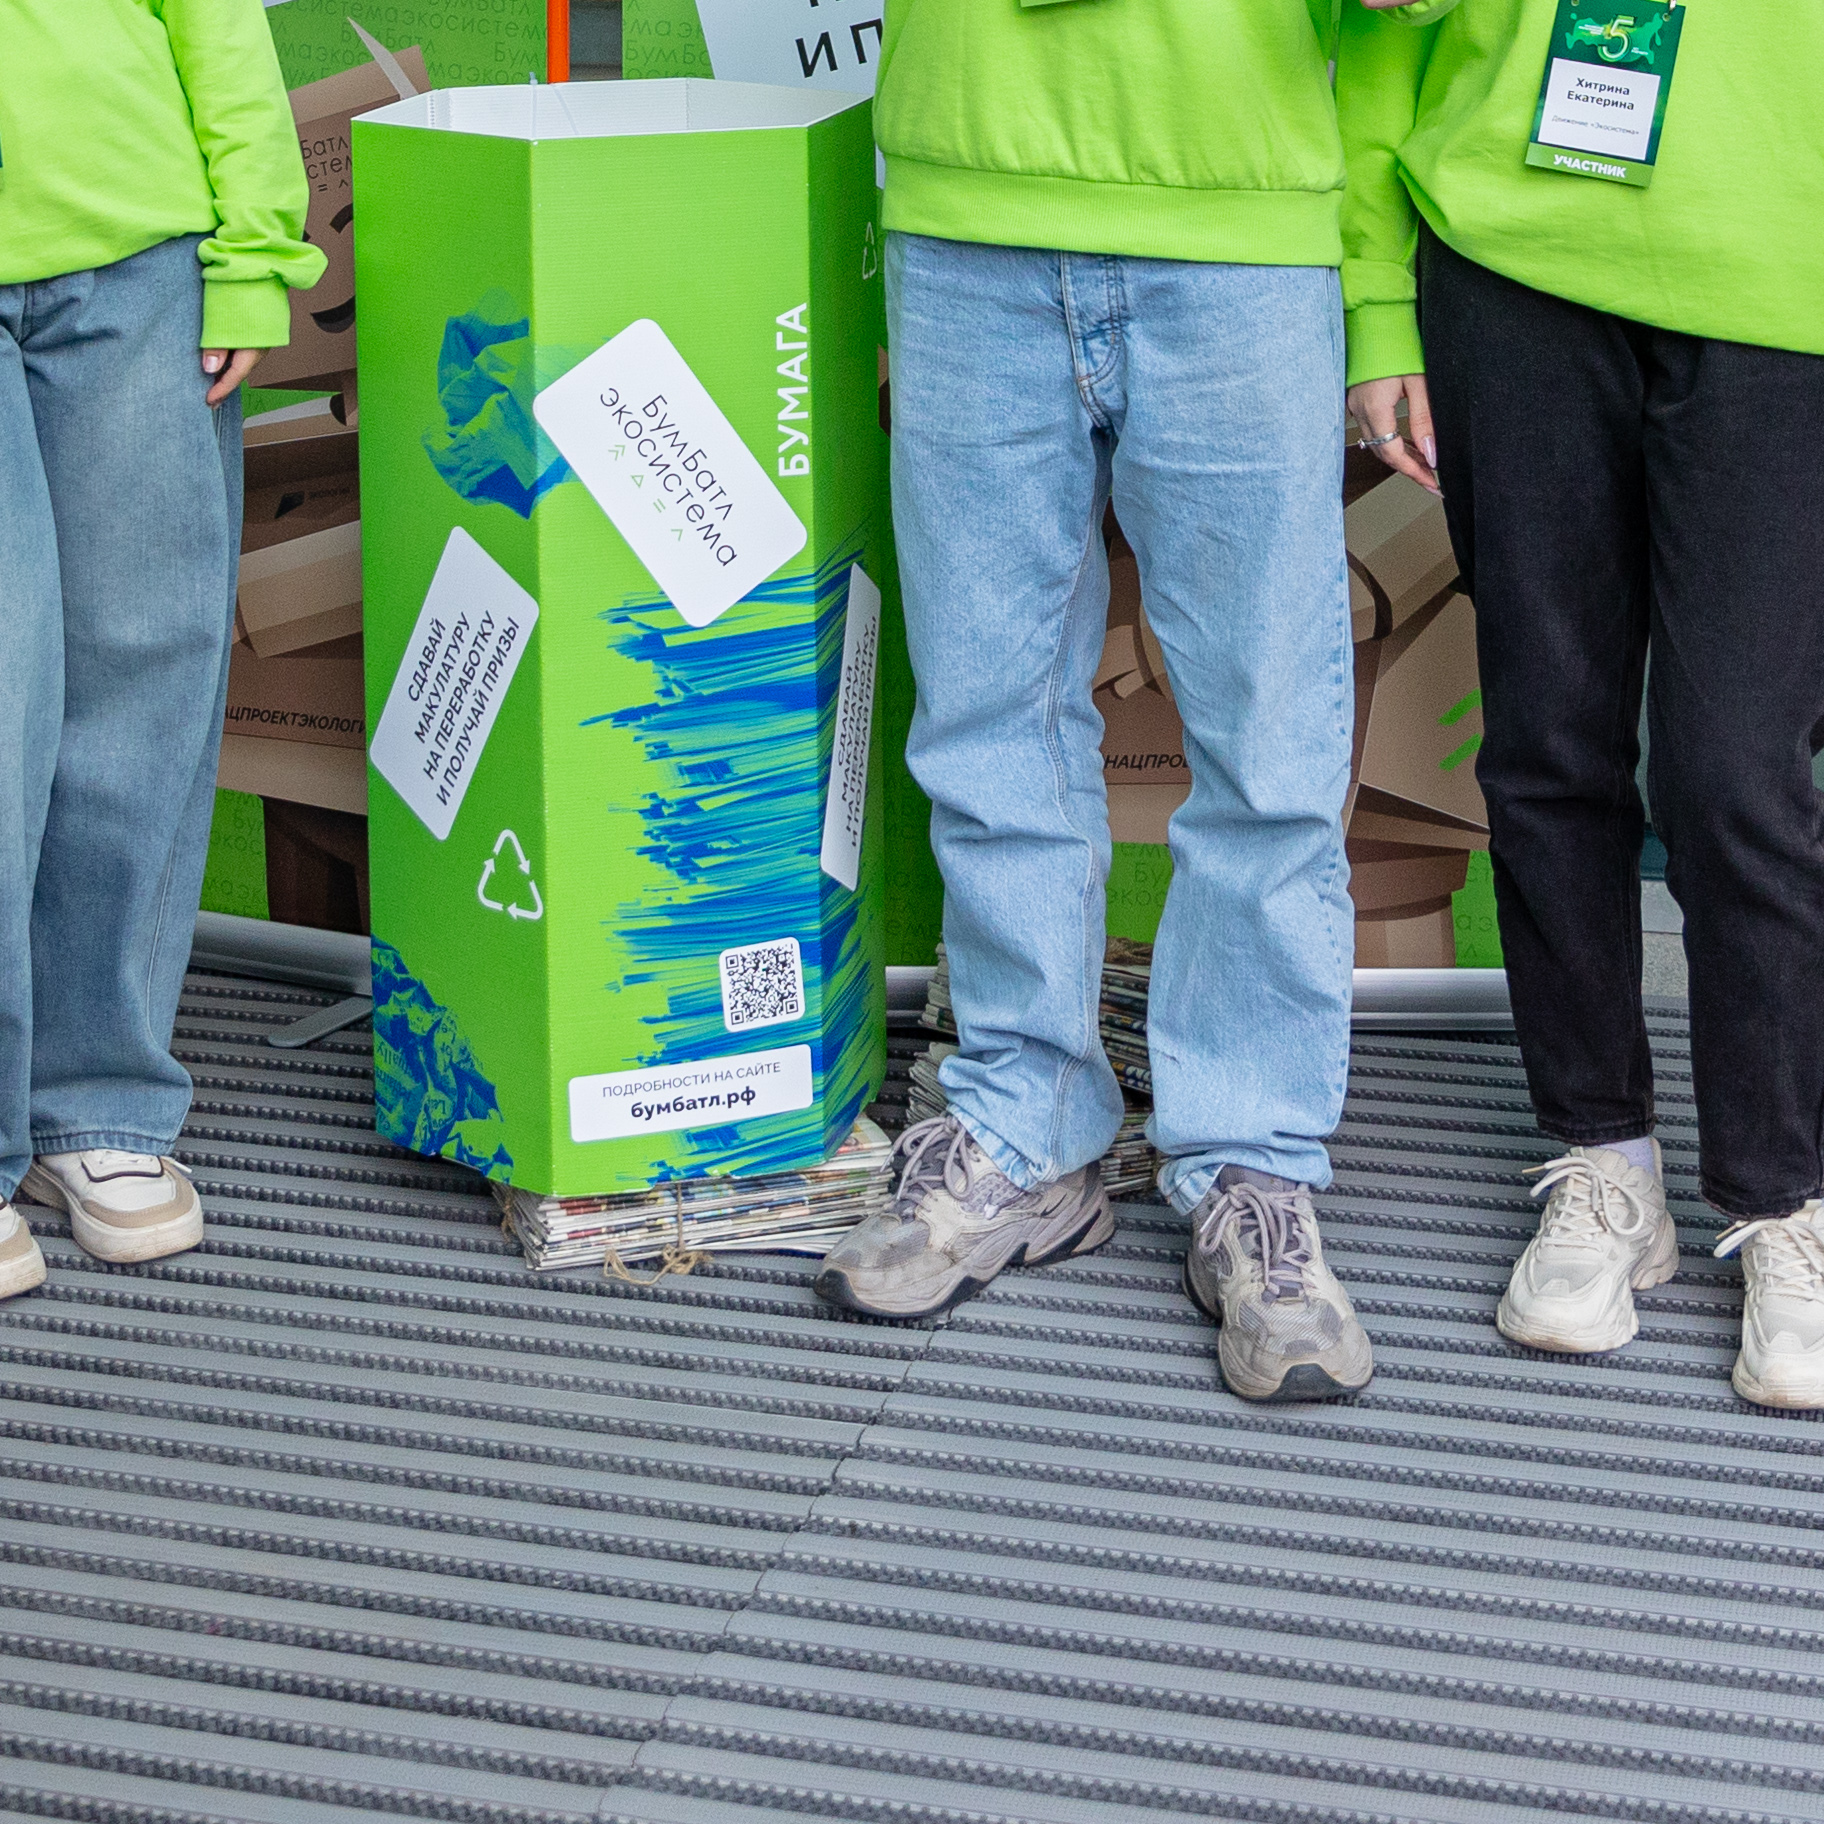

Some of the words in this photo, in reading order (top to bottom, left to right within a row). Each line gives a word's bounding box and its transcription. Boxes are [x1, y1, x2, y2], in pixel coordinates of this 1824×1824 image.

[795, 31, 838, 78] И
[1598, 14, 1636, 63] 5
[1567, 90, 1635, 111] Екатерина
[1576, 77, 1630, 96] Хитрина
[300, 136, 349, 160] Батл
[1554, 154, 1627, 178] УЧАСТНИК
[776, 302, 811, 477] БУМАГА
[600, 387, 738, 567] экосистема
[642, 394, 734, 521] БумБатл
[408, 617, 447, 702] СДАВАЙ
[414, 612, 471, 744] МАКУЛАТУРУ
[481, 616, 520, 692] ПРИЗЫ
[422, 750, 443, 780] НА
[434, 610, 495, 751] ПЕРЕРАБОТКУ
[838, 664, 853, 767] СДАВАЙ
[841, 640, 861, 802] МАКУЛАТУРУ
[846, 799, 854, 833] НА
[850, 623, 870, 794] ПЕРЕРАБОТКУ
[443, 691, 490, 788] ПОЛУЧАЙ
[436, 784, 451, 807] И
[602, 1073, 711, 1098] ПОДРОБНОСТИ
[714, 1070, 733, 1082] НА
[736, 1061, 781, 1078] САЙТЕ
[631, 1085, 756, 1121] бумбатл.рф
